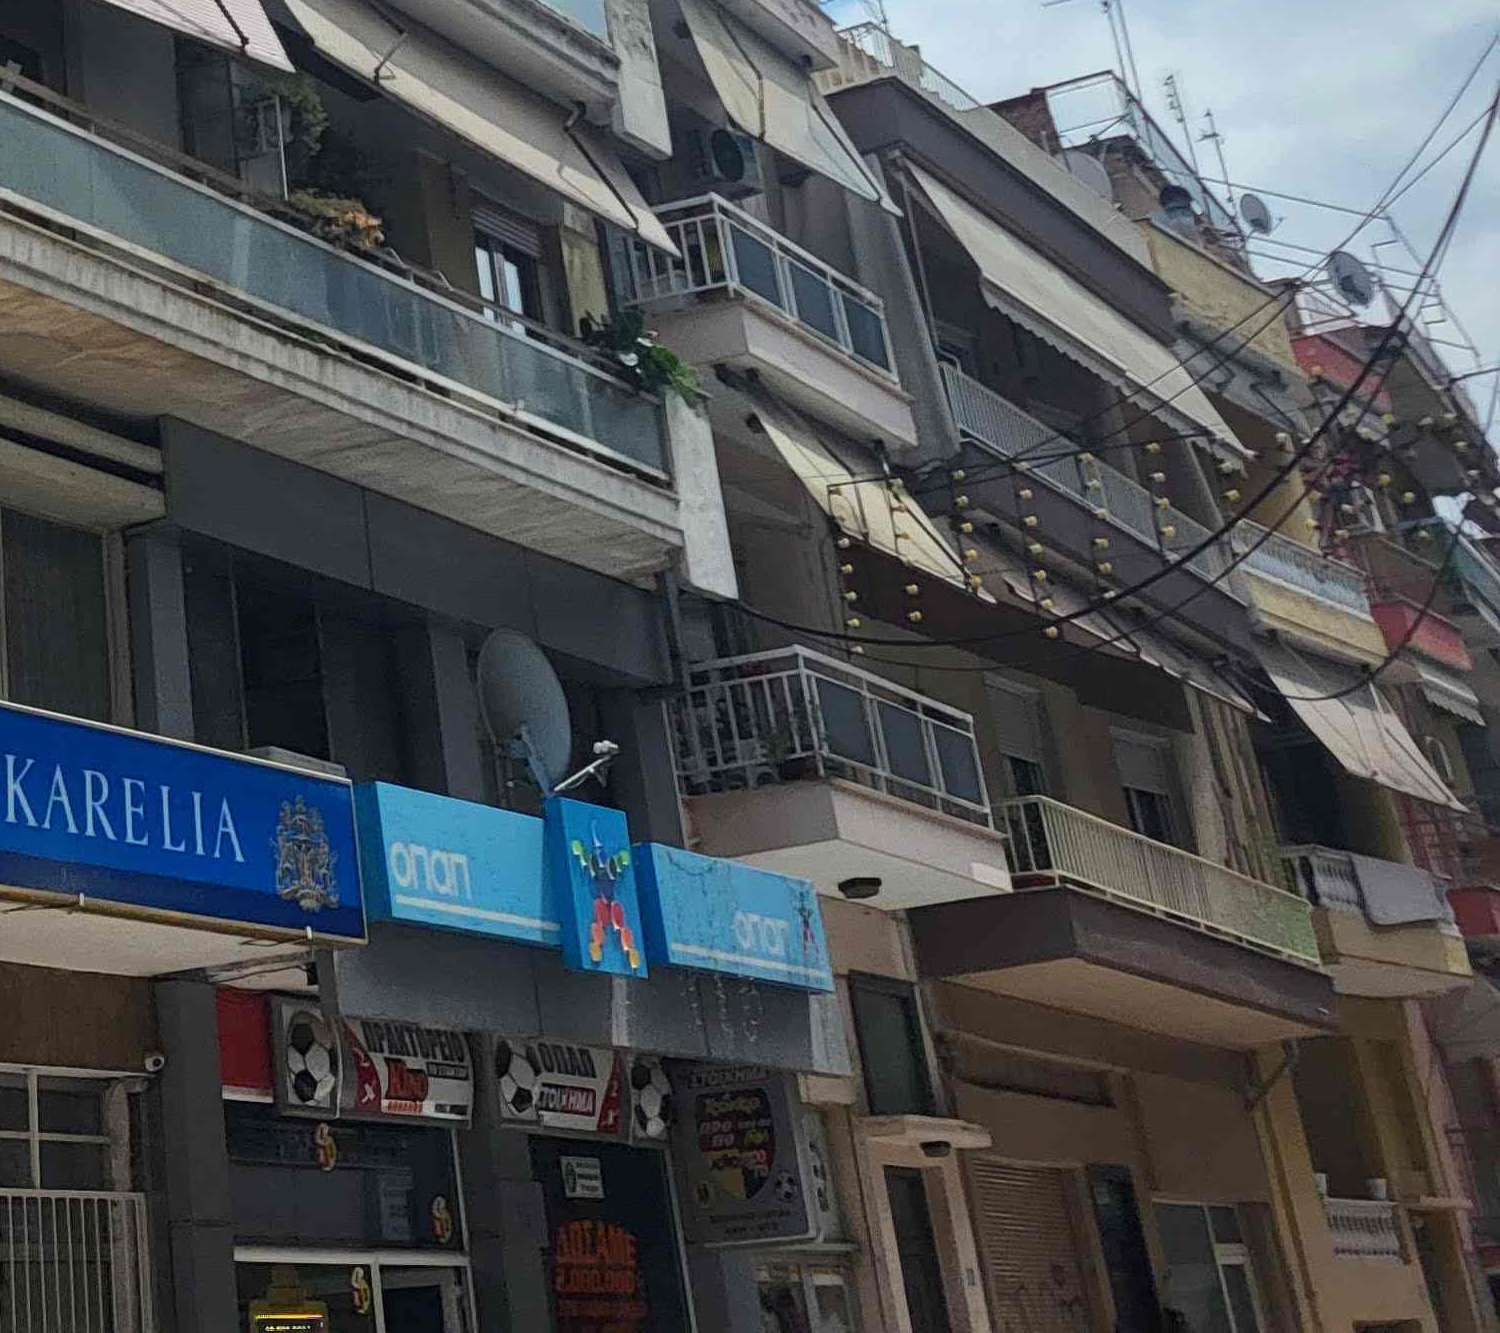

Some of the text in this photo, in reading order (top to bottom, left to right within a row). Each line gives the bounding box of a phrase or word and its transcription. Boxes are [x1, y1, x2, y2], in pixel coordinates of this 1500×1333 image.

[3, 753, 246, 863] KARELIA
[360, 1020, 465, 1063] ΠΡΑΚΤΟΡΕΙΟ
[537, 1041, 597, 1079] ΟΠΑΠ
